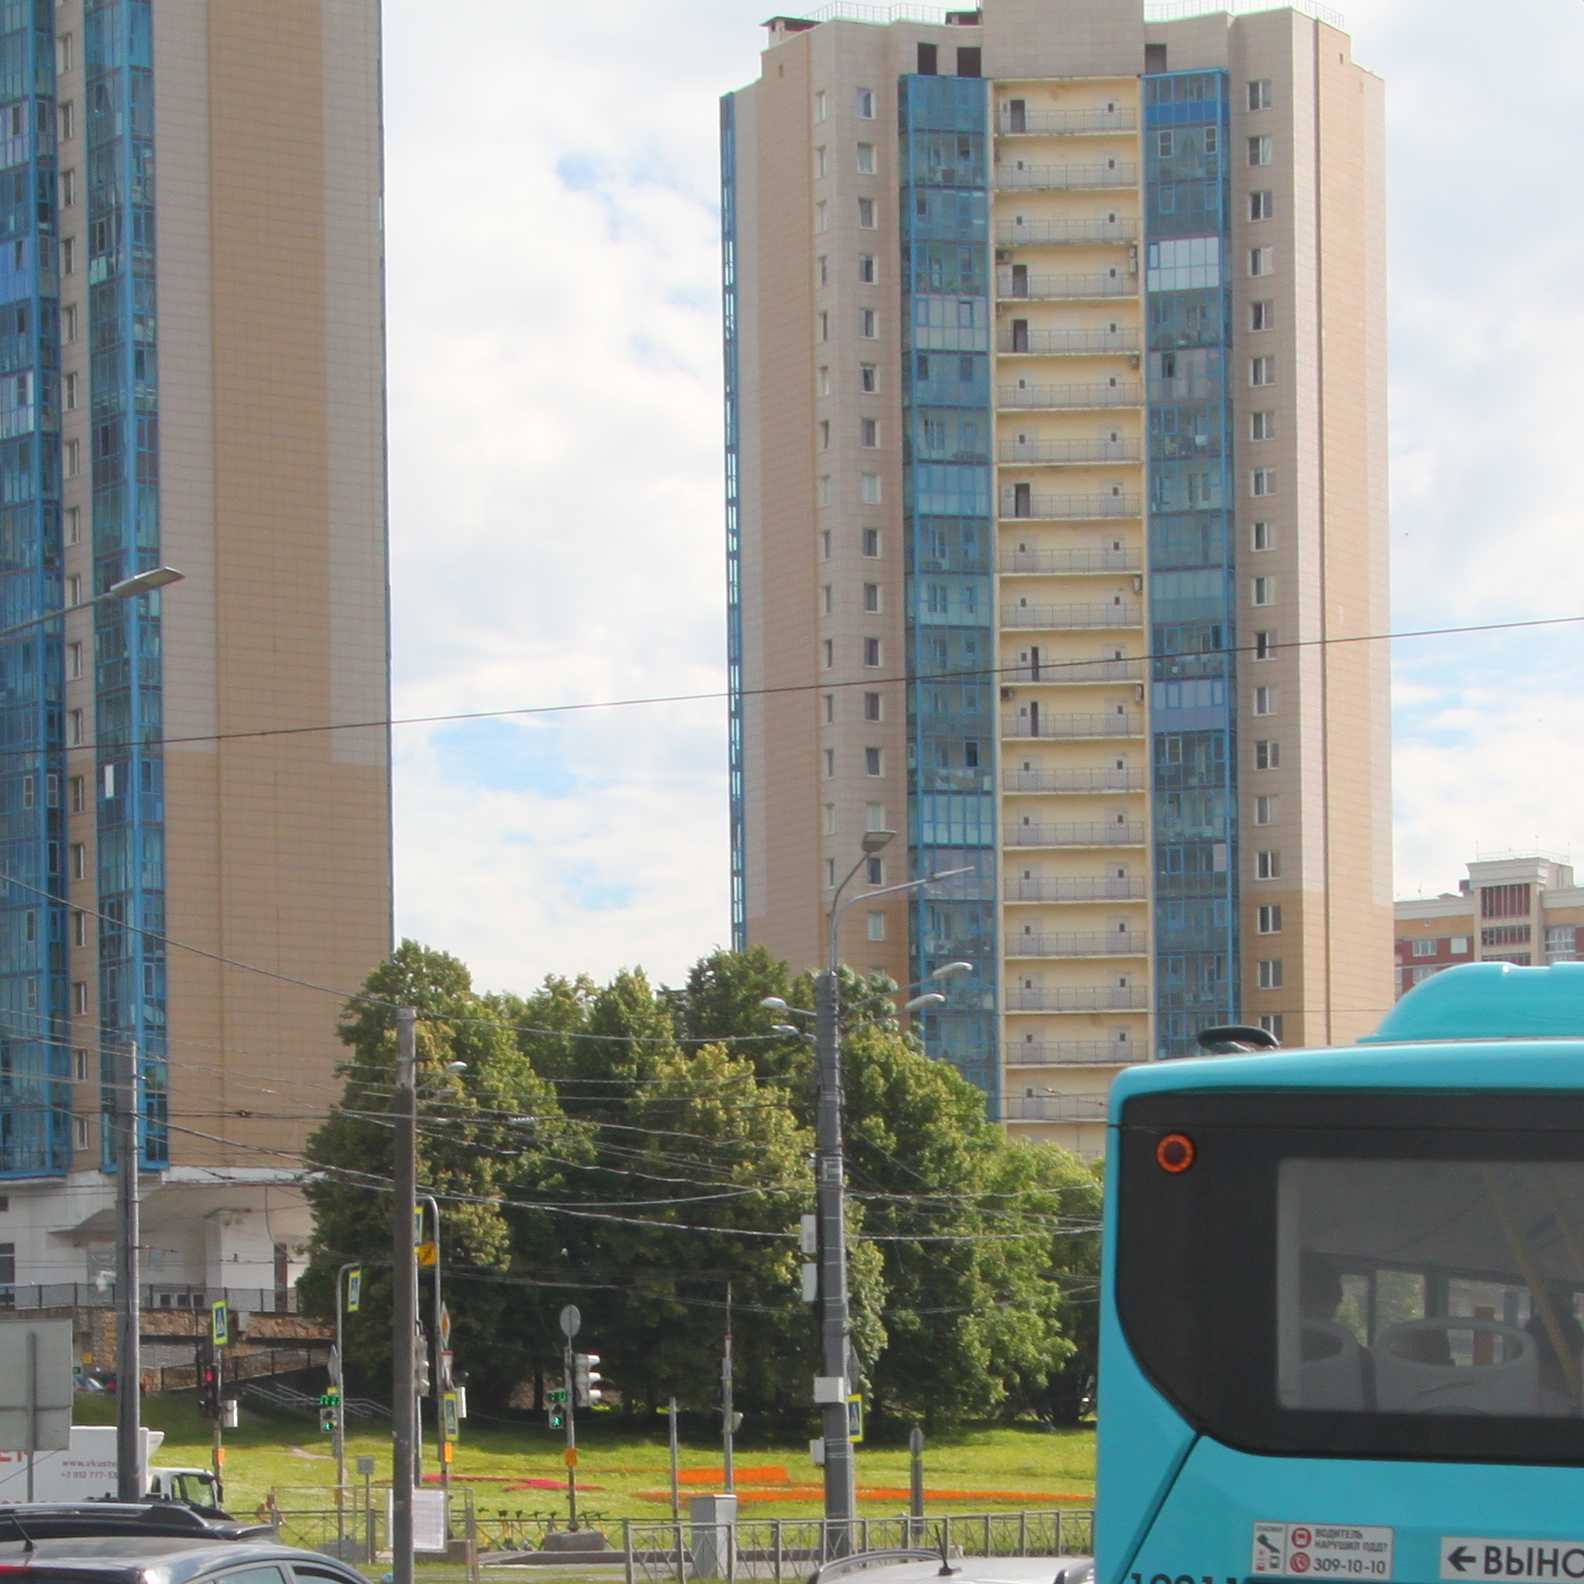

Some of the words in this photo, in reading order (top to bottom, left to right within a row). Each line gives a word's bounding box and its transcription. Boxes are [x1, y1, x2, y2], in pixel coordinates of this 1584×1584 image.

[1314, 1528, 1363, 1539] ВОДИТЕЛЬ
[1314, 1540, 1361, 1551] НАРУШИЛ
[1313, 1558, 1386, 1574] 309-10-10
